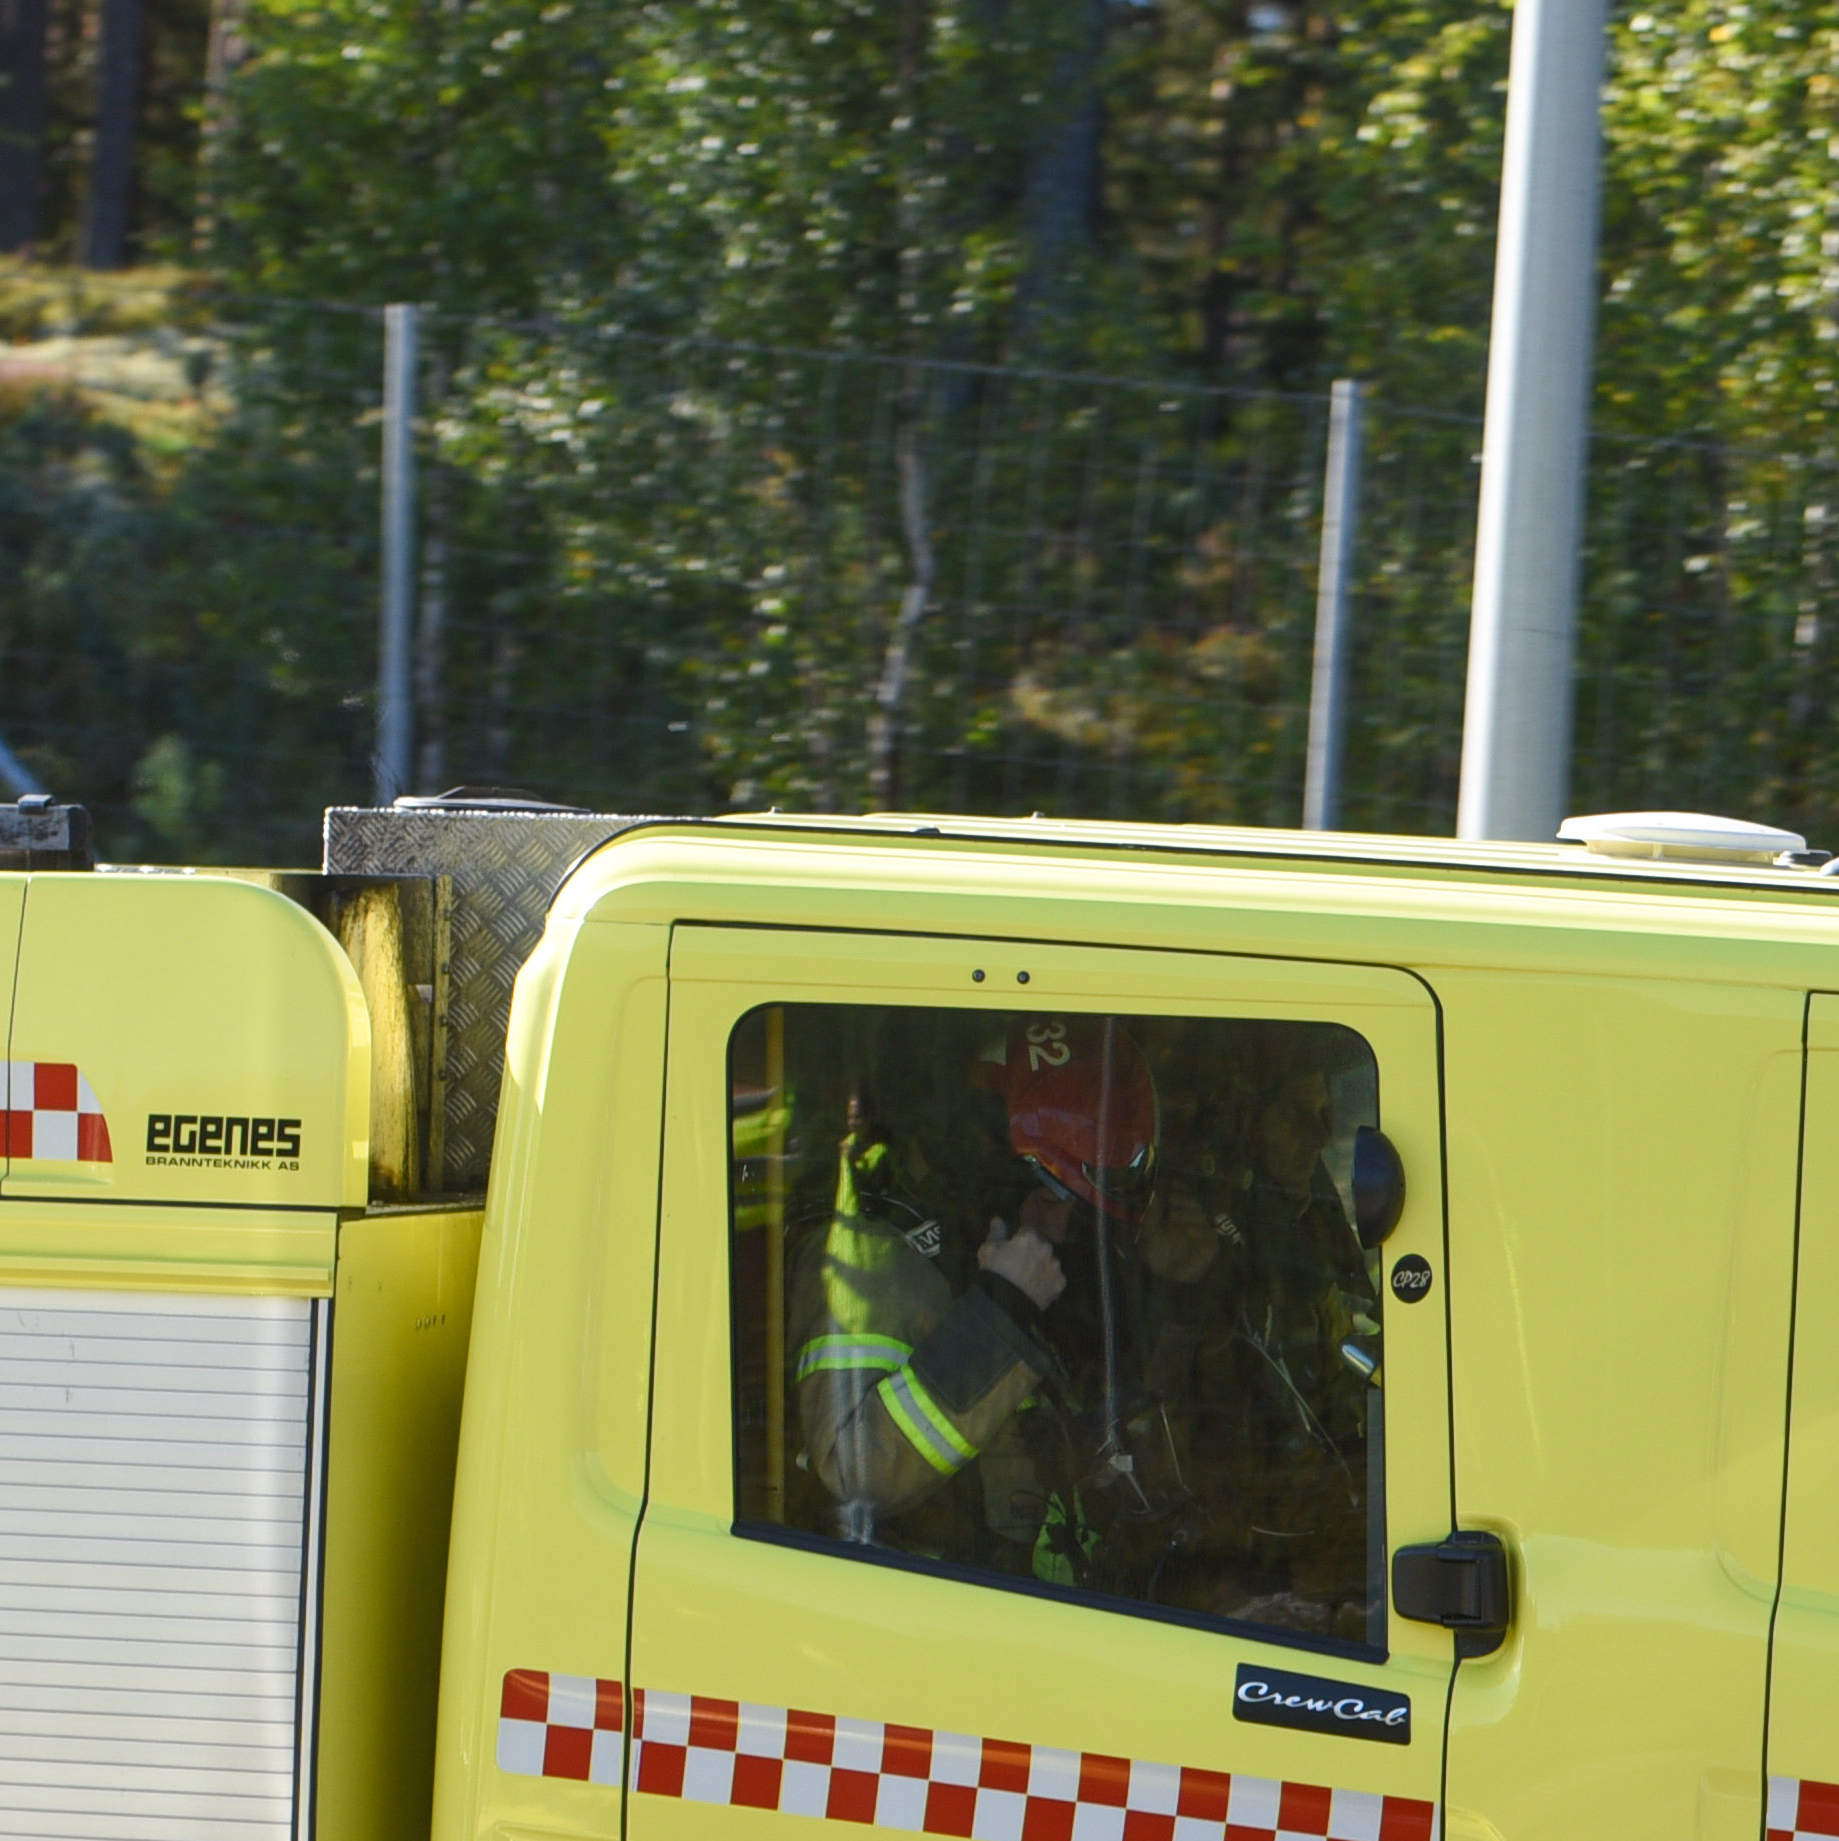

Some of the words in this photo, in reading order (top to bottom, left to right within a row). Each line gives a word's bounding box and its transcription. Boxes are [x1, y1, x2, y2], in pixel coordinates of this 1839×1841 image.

[1026, 1022, 1071, 1072] 32
[145, 1156, 271, 1170] BRANNTEKNIKK
[277, 1161, 300, 1171] AS
[1393, 1270, 1431, 1289] CP28
[1237, 1680, 1408, 1727] CrewCab
